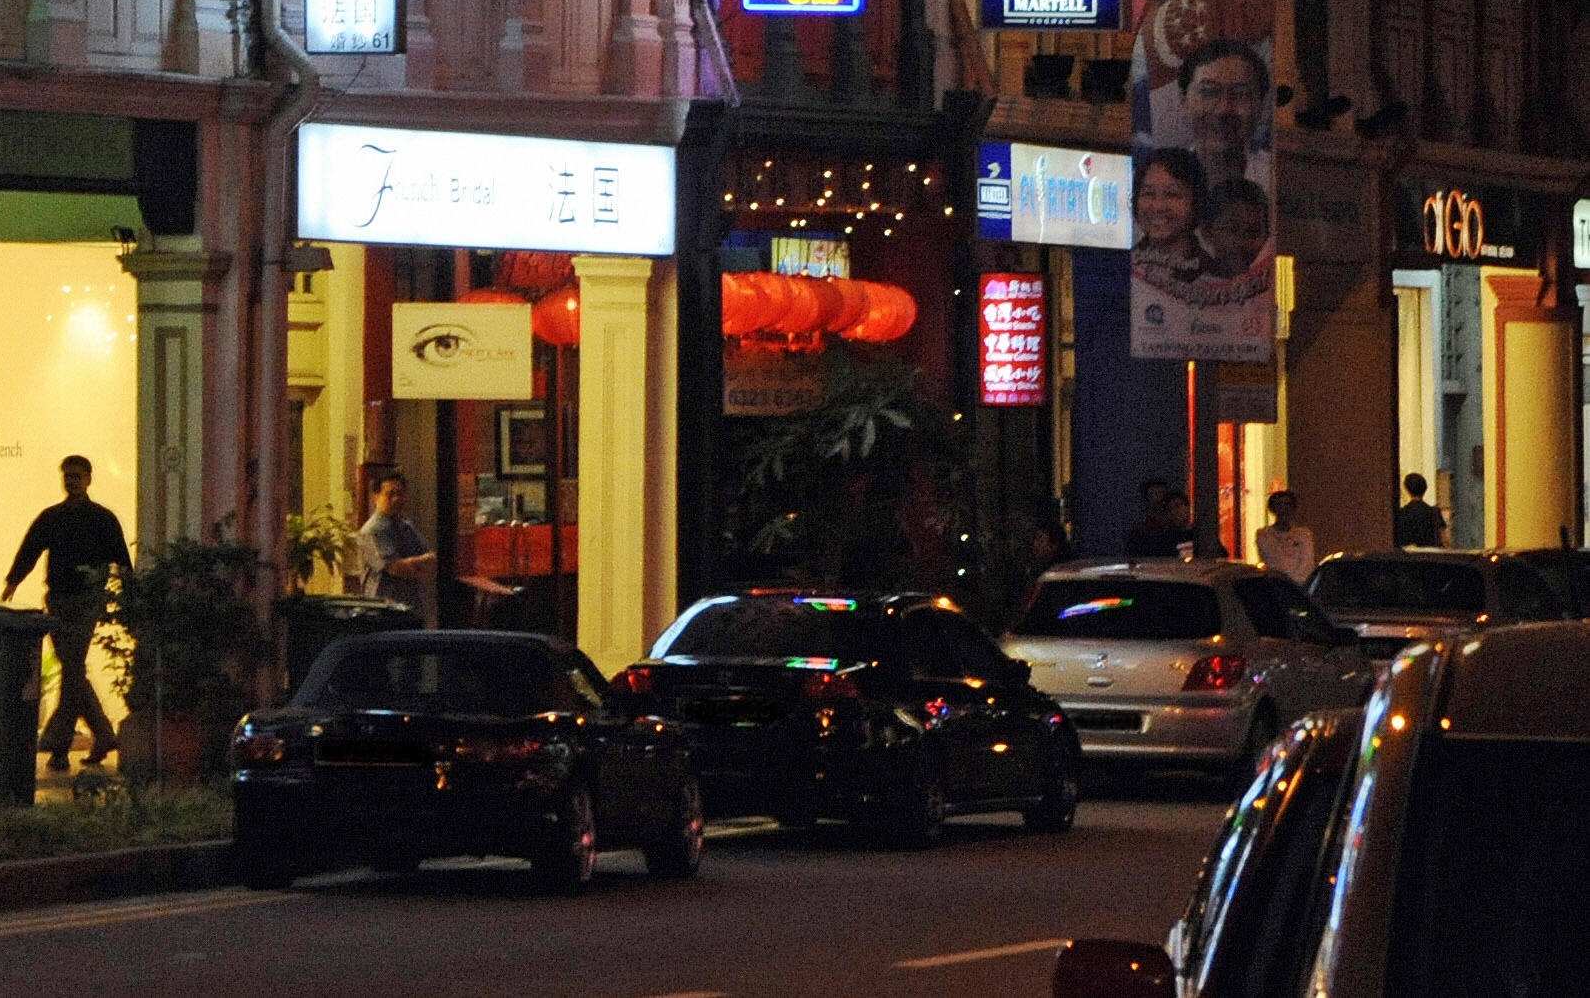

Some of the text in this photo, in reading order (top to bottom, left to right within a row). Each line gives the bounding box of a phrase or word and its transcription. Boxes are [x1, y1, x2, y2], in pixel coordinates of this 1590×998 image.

[372, 32, 390, 49] 61
[451, 177, 495, 205] Bridal
[548, 163, 619, 224] 法国
